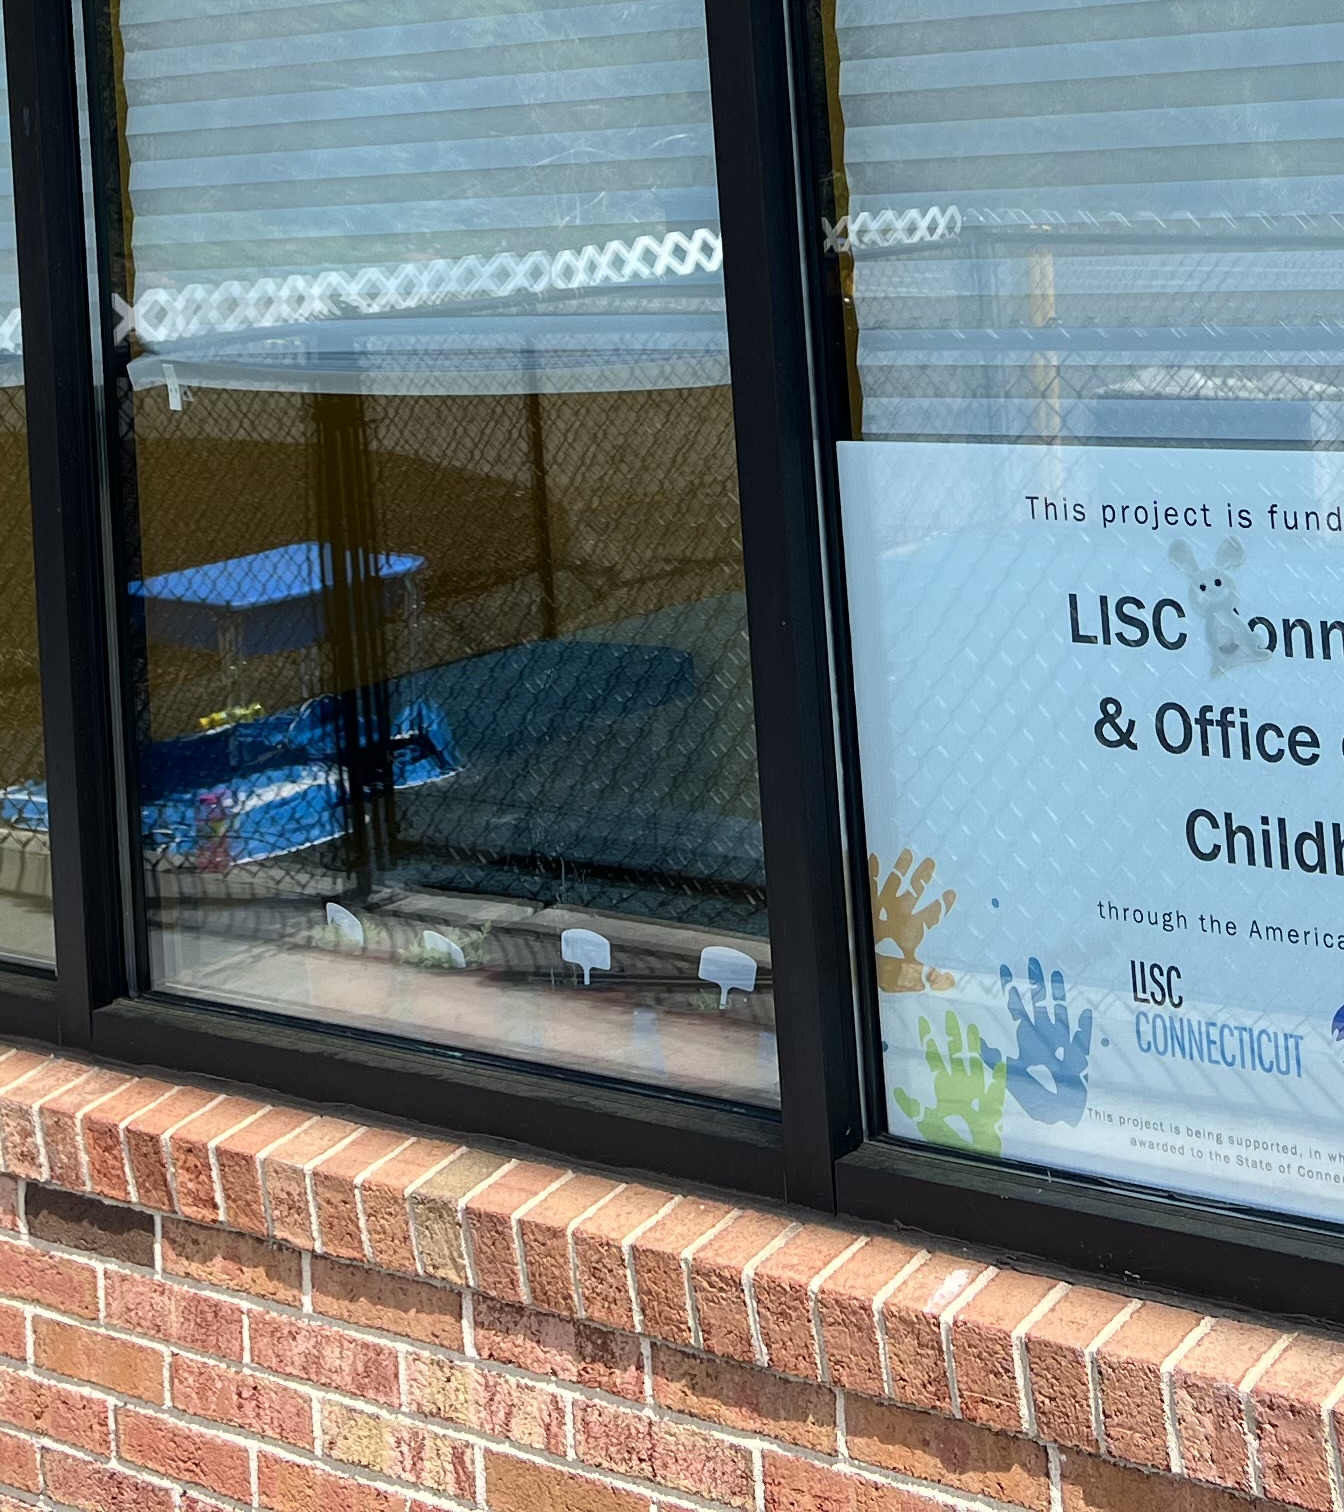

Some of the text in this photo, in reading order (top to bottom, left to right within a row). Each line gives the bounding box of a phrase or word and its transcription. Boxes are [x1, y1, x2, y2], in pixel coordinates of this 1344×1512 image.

[1024, 496, 1087, 524] This
[1100, 499, 1213, 531] project
[1227, 503, 1253, 530] is
[1067, 592, 1189, 652] LISC
[1093, 696, 1139, 752] &
[1155, 701, 1321, 767] Office
[1097, 899, 1189, 934] through
[1198, 912, 1238, 938] the
[1129, 959, 1185, 1010] LISC
[1135, 1010, 1305, 1080] CONNECTICUT
[1087, 1106, 1114, 1125] This
[1118, 1114, 1166, 1133] project
[1169, 1122, 1182, 1136] is
[1186, 1125, 1224, 1146] being
[1227, 1133, 1304, 1160] supported,
[1309, 1147, 1322, 1161] in
[1130, 1136, 1185, 1156] awarded
[1190, 1145, 1204, 1160] to
[1208, 1148, 1231, 1165] the
[1235, 1154, 1273, 1173] State
[1278, 1162, 1292, 1176] of
